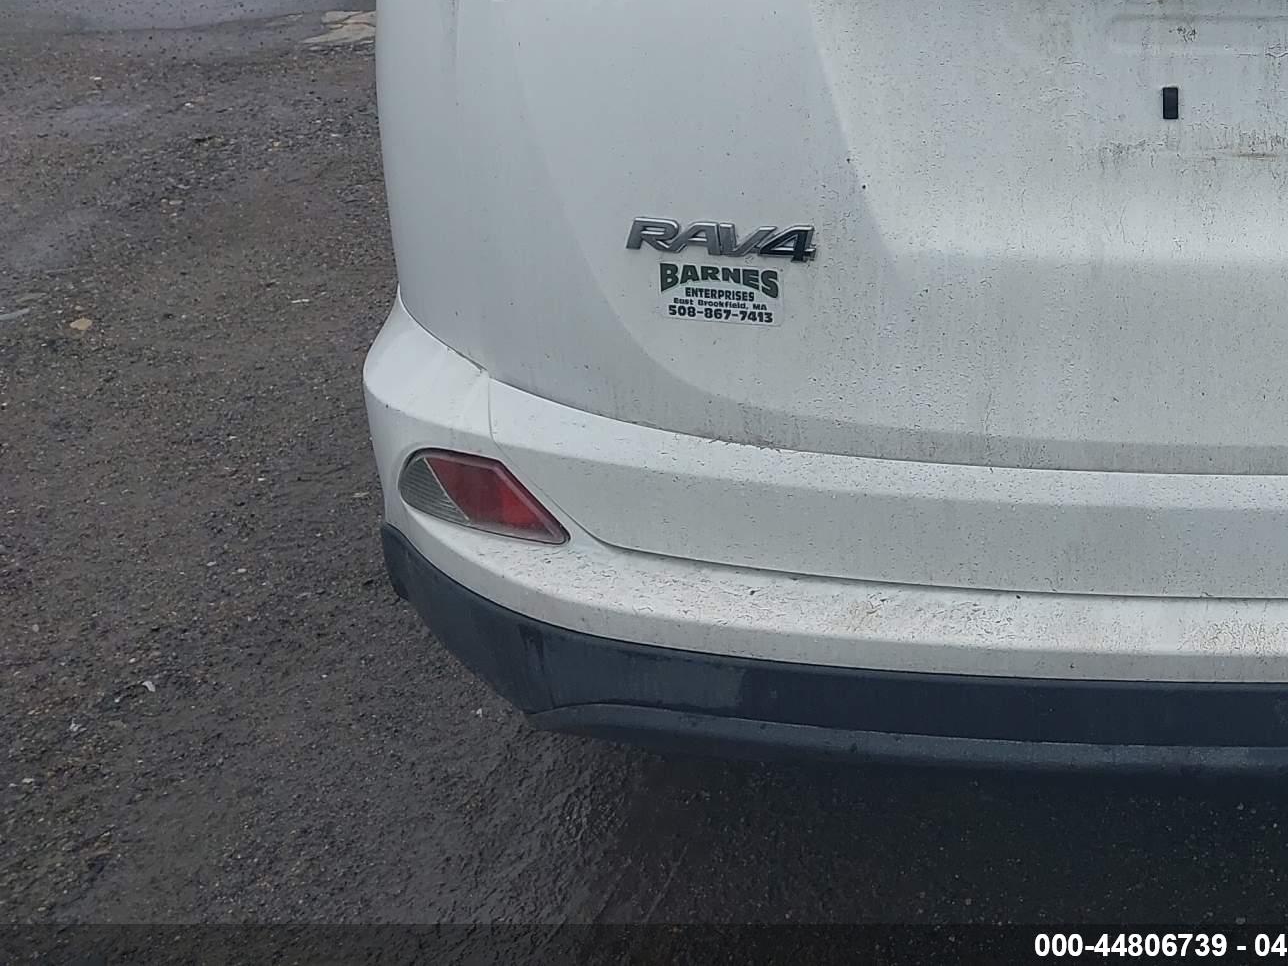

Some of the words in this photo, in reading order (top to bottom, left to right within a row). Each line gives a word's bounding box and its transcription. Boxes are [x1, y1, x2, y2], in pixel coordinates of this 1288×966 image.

[626, 217, 816, 262] RAV4
[660, 263, 778, 299] BARNES
[685, 287, 754, 301] ENTERPRISES
[668, 305, 773, 323] 508-867-7413
[752, 303, 768, 311] MA
